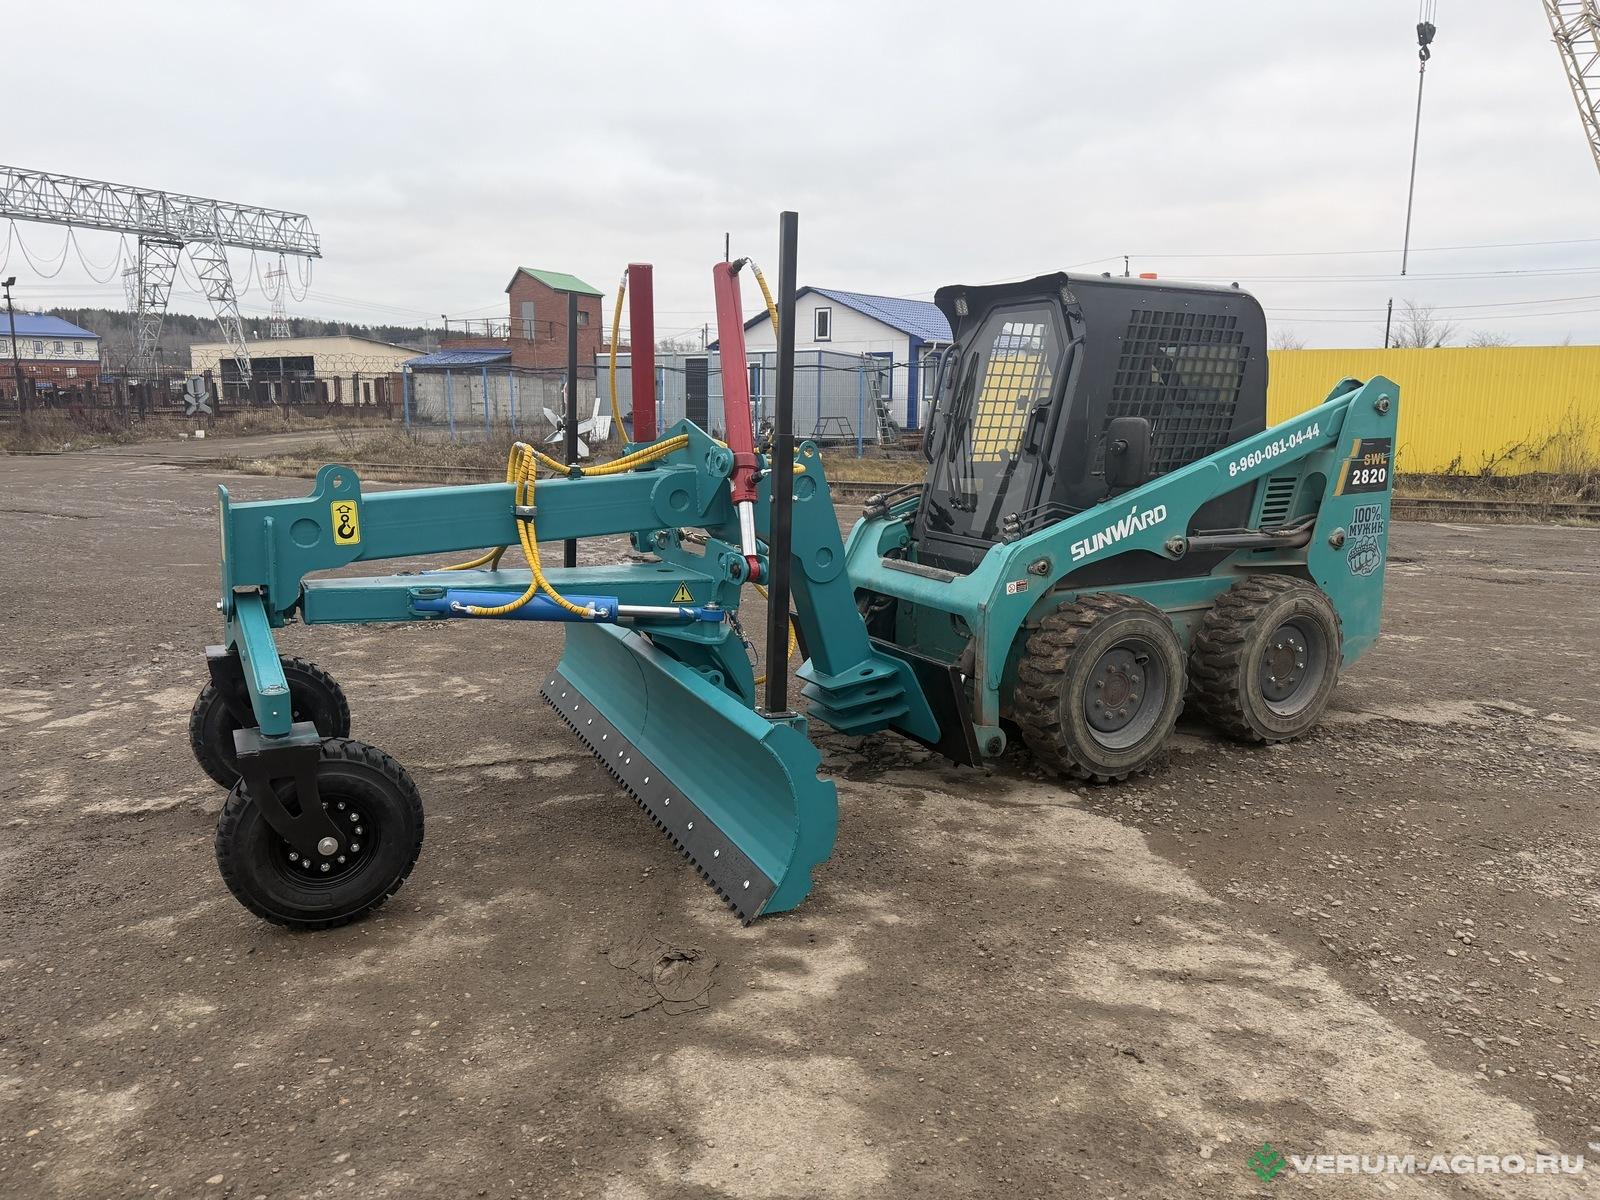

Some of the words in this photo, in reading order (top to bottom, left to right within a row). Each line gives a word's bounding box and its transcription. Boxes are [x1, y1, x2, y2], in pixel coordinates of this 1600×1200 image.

[1228, 422, 1320, 477] 8-960-081-04-44
[1363, 453, 1387, 466] SWL
[1352, 468, 1386, 485] 2820
[1354, 506, 1381, 523] 100%
[1070, 504, 1167, 561] SUNWARD
[1349, 521, 1384, 537] МУЖИК
